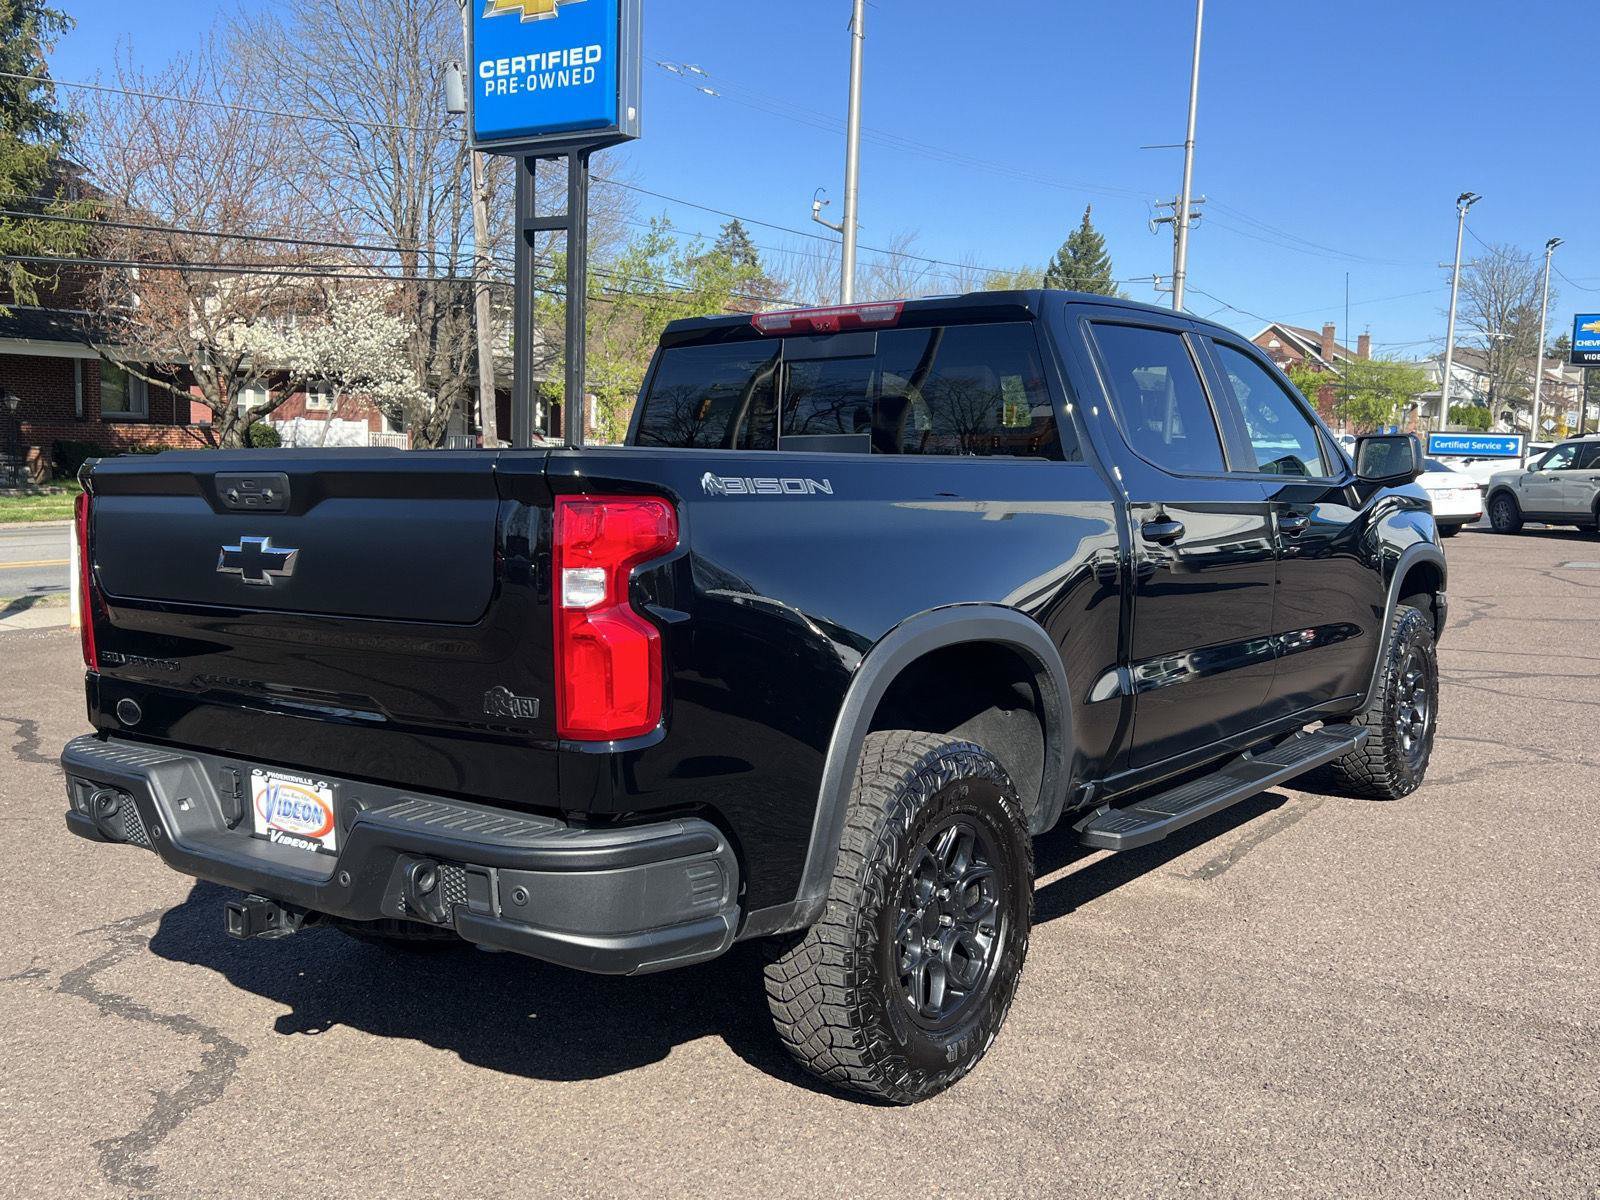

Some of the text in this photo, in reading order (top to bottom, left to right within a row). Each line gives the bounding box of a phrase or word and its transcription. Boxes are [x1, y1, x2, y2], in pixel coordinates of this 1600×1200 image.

[479, 44, 602, 79] CERTIFIED
[485, 66, 595, 97] PRE-OWNED
[1566, 418, 1576, 426] 35
[1434, 440, 1502, 450] Certified Service
[719, 477, 834, 495] BISON
[265, 783, 324, 825] VIDEON
[269, 829, 319, 852] VIDEON
